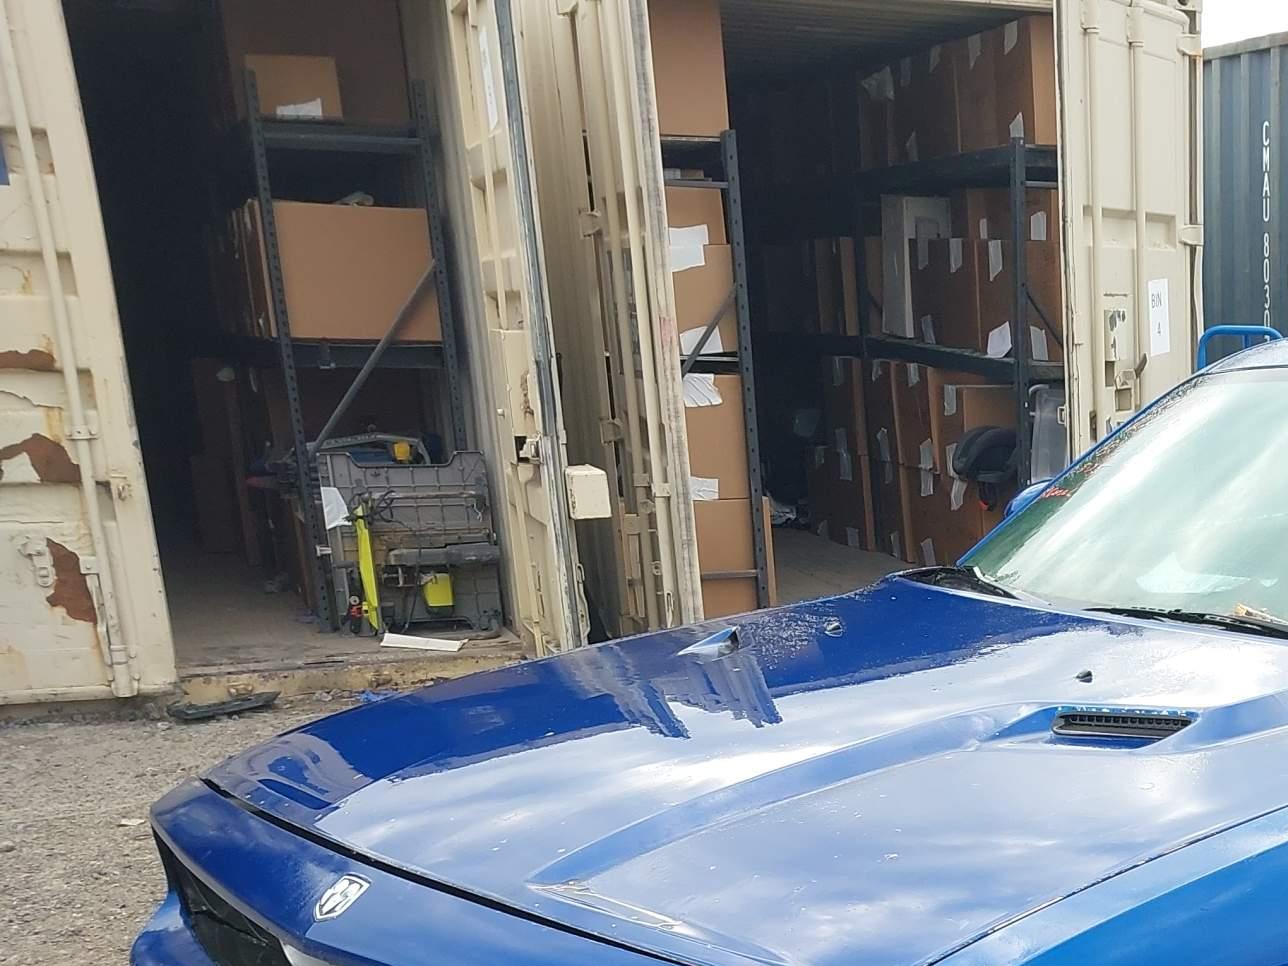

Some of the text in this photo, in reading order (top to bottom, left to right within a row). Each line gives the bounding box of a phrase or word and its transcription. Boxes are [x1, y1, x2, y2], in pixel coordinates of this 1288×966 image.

[1262, 121, 1271, 343] CMAU 8030
[1151, 291, 1163, 309] BIN
